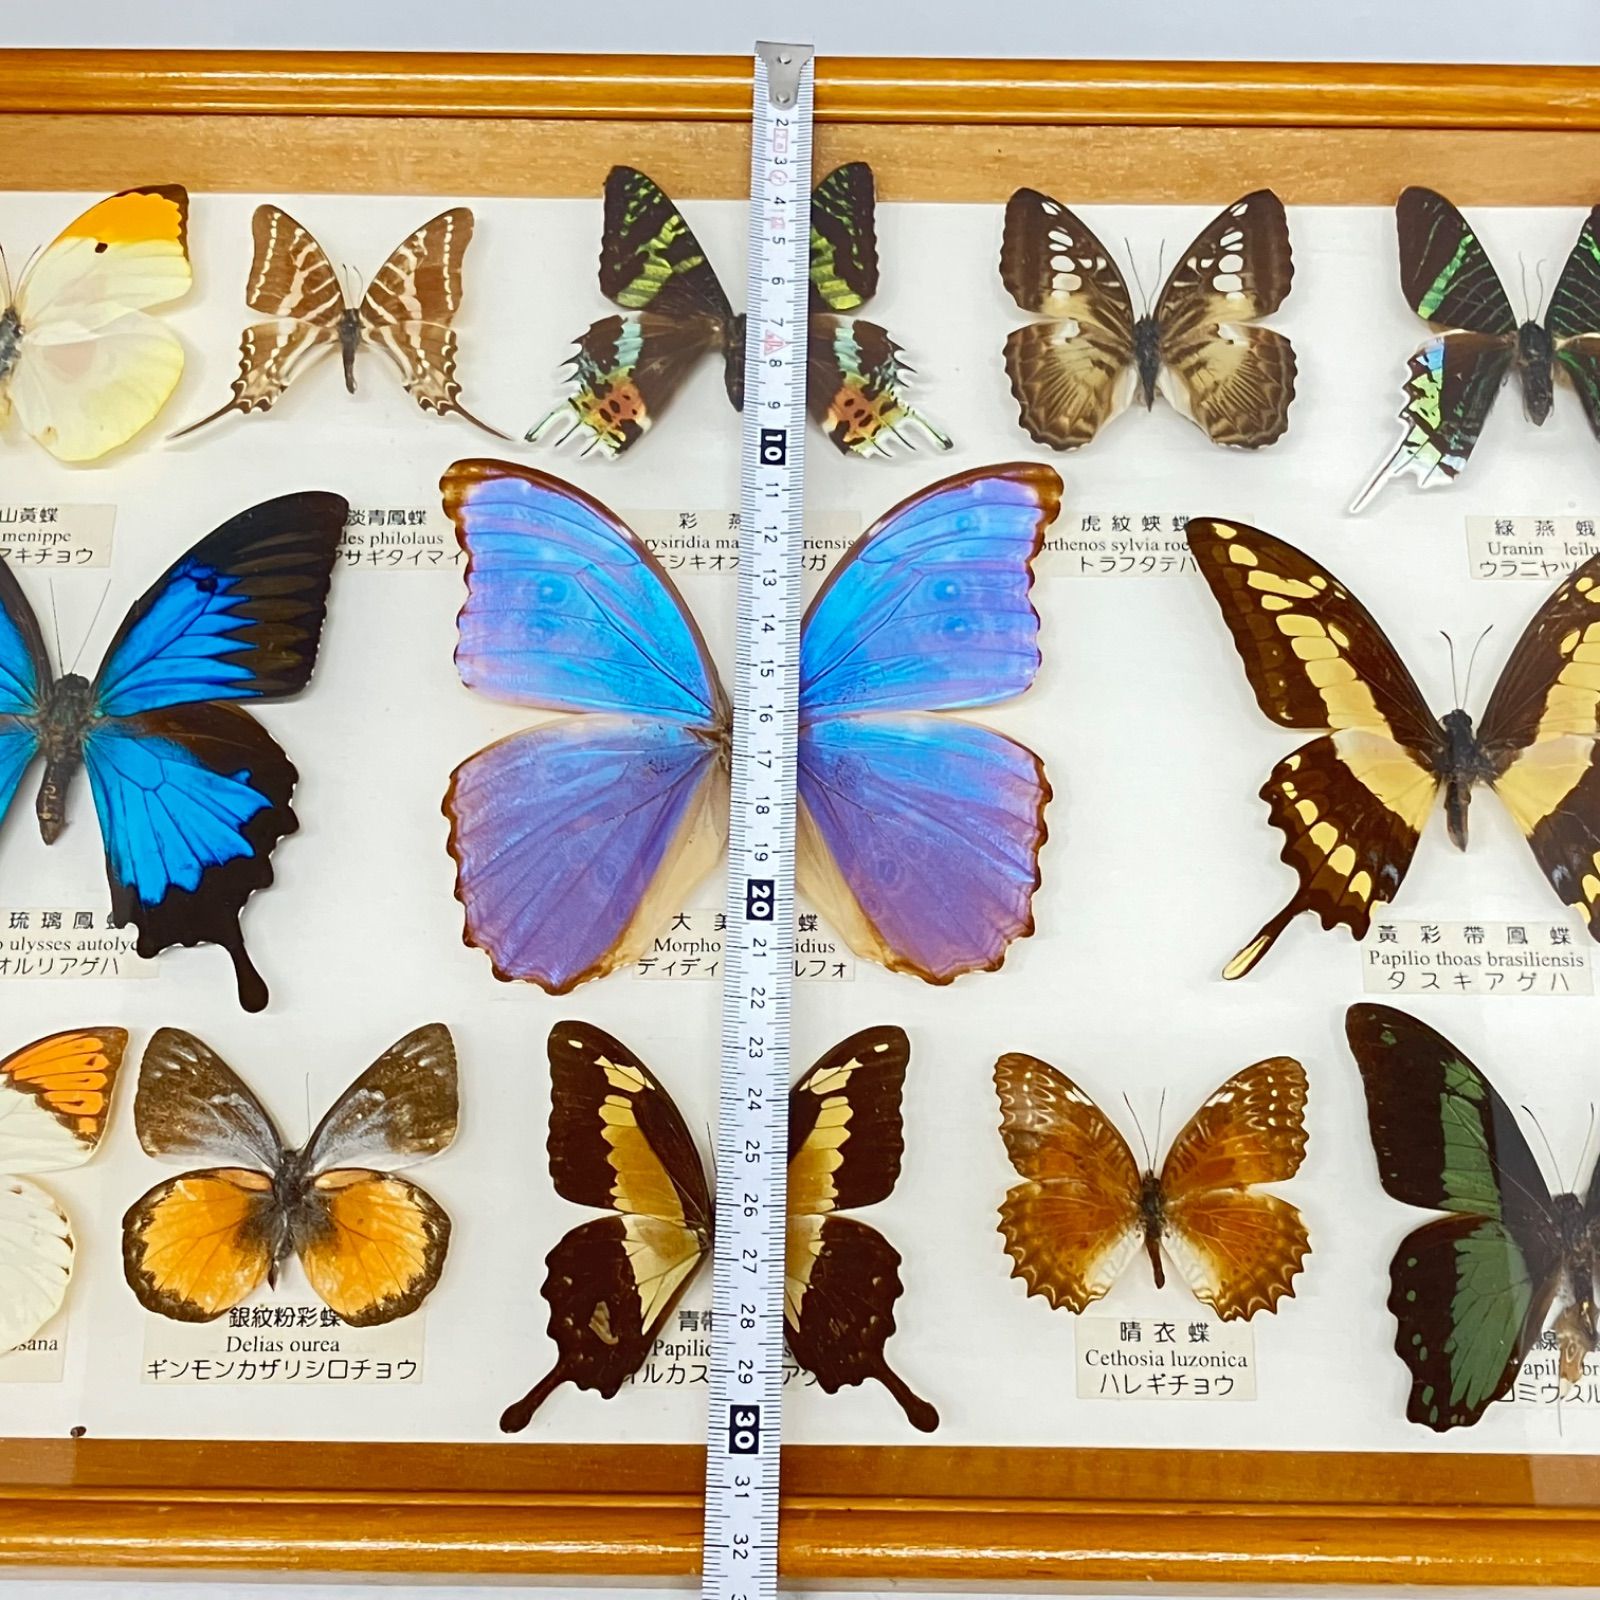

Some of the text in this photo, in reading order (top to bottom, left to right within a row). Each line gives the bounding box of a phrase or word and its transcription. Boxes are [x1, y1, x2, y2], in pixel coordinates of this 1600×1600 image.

[776, 119, 788, 127] 2
[774, 157, 787, 165] 3
[773, 196, 786, 205] 4
[772, 236, 785, 245] 5
[771, 277, 784, 285] 6
[770, 317, 783, 327] 7
[769, 359, 782, 367] 8
[768, 401, 781, 409] 9
[764, 433, 783, 461] 10
[765, 482, 779, 498] 11
[2, 530, 71, 545] menippe
[370, 532, 444, 548] philolaus
[645, 532, 711, 553] rysiridia
[764, 525, 778, 544] 12
[1111, 538, 1159, 554] sylvia
[1488, 541, 1544, 555] Uranin
[763, 568, 777, 586] 13
[761, 614, 775, 633] 14
[760, 659, 774, 677] 15
[759, 704, 773, 722] 16
[757, 749, 771, 768] 17
[755, 796, 770, 814] 18
[754, 843, 768, 861] 19
[751, 884, 771, 918] 20
[10, 936, 71, 954] ulysses
[654, 938, 836, 955] Morpho idius
[753, 938, 767, 957] 21
[1369, 950, 1584, 968] Papilio thoas brasiliensis
[1387, 971, 1569, 991] タスキアゲハ
[751, 987, 765, 1008] 22
[749, 1037, 763, 1058] 23
[748, 1088, 762, 1110] 24
[745, 1140, 760, 1163] 25
[744, 1193, 758, 1217] 26
[743, 1249, 757, 1273] 27
[229, 1307, 341, 1328] 銀紋粉彩蝶
[741, 1304, 756, 1329] 28
[1120, 1321, 1210, 1343] 晴衣蝶
[227, 1336, 340, 1352] Delias ourea
[1086, 1350, 1248, 1367] Cethosia luzonica
[148, 1359, 418, 1380] ギンモンカザリシロチョウ
[739, 1360, 754, 1384] 29
[1100, 1373, 1234, 1396] ハレギチョウ
[734, 1411, 756, 1449] 30
[735, 1476, 750, 1498] 31
[733, 1534, 749, 1560] 32
